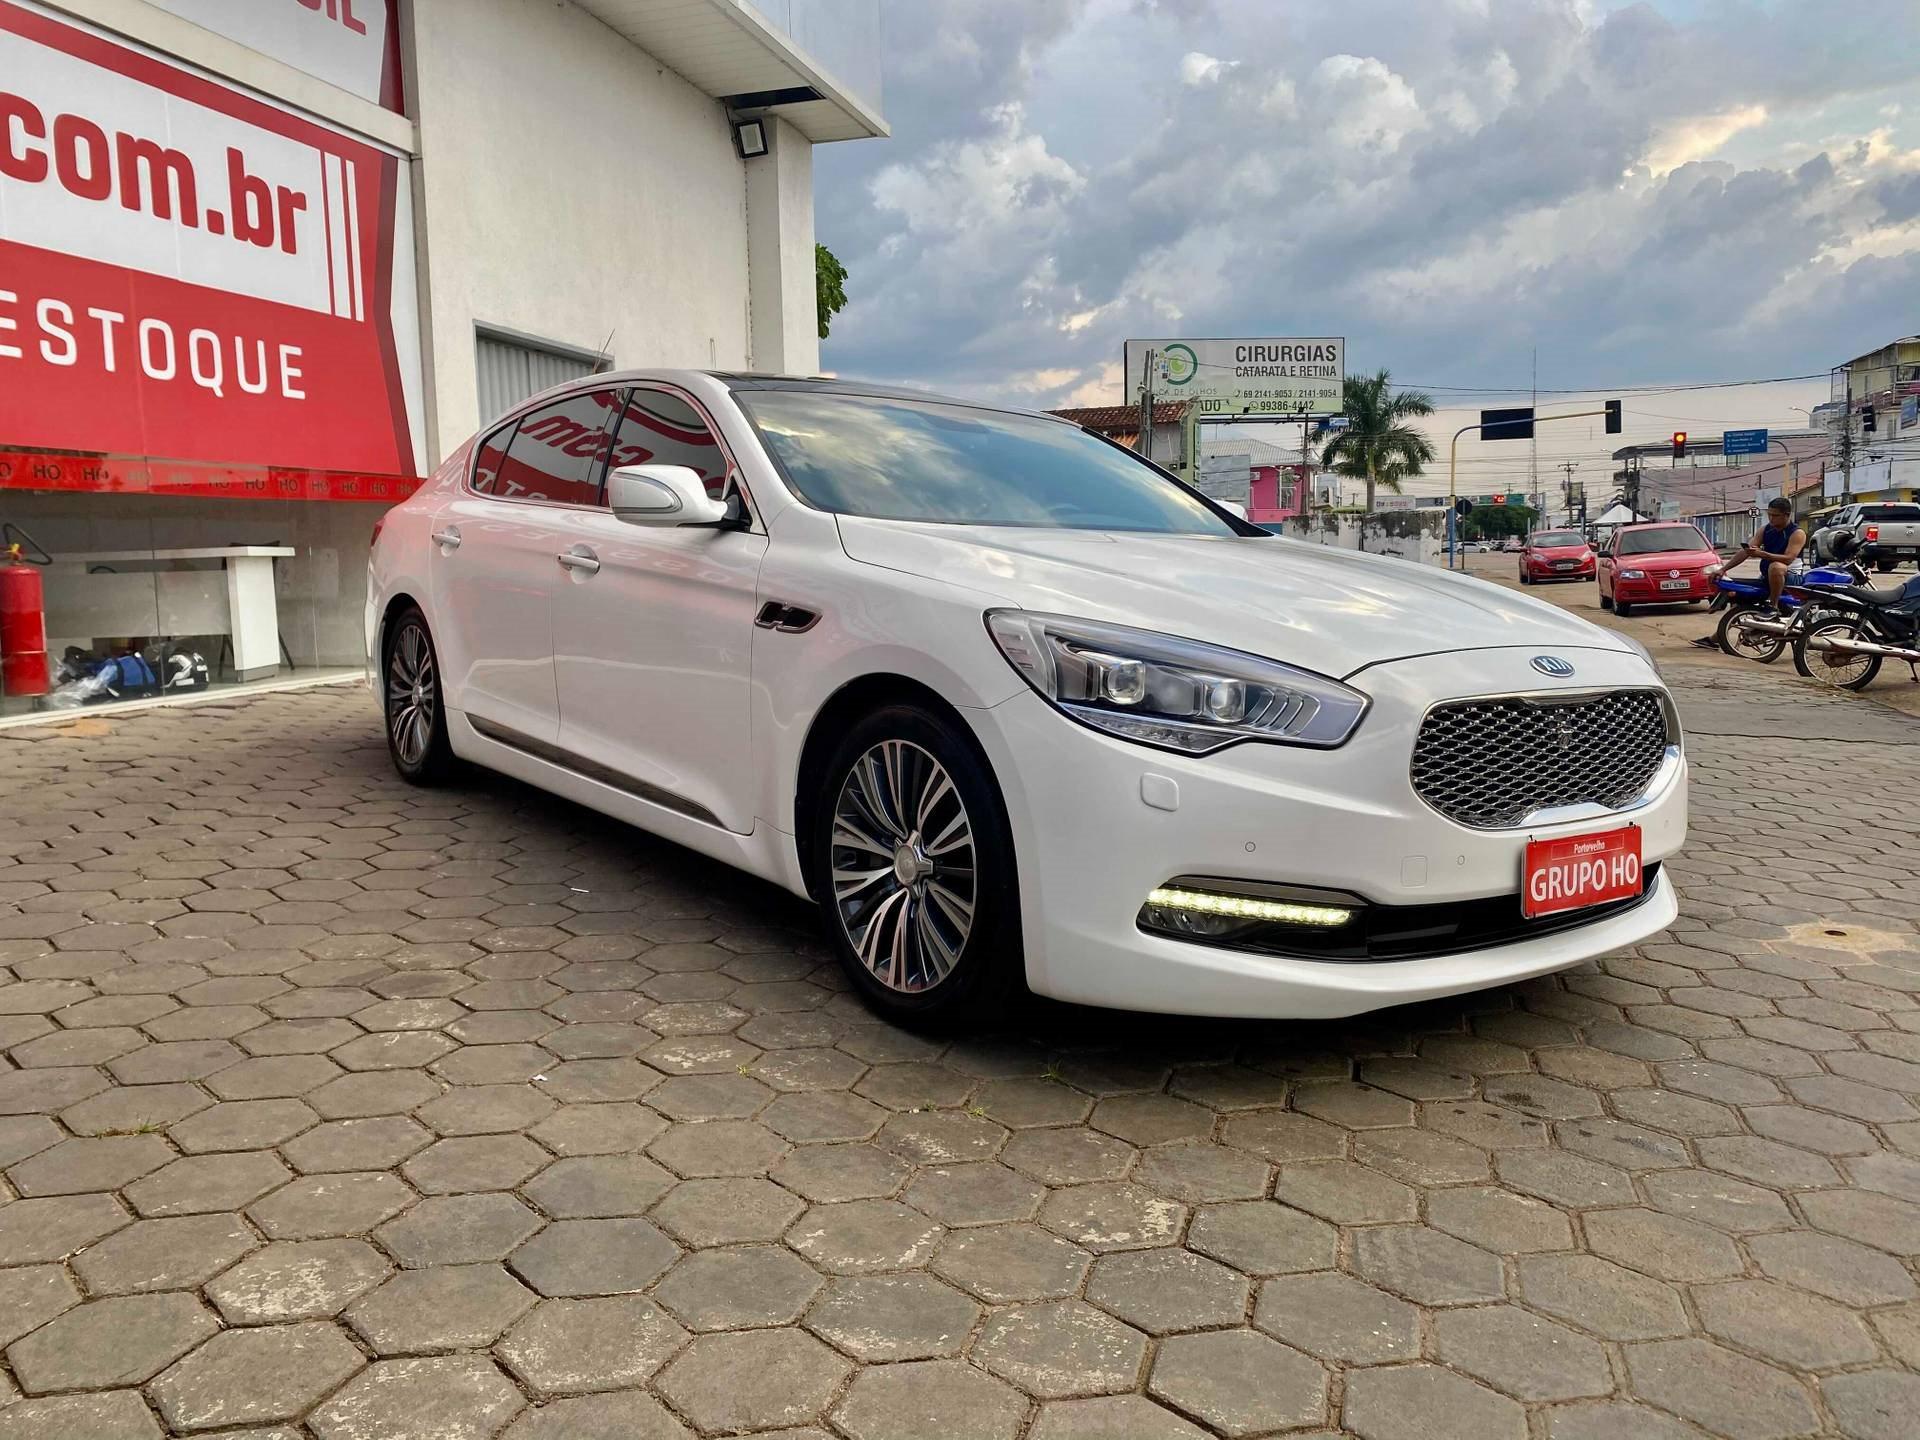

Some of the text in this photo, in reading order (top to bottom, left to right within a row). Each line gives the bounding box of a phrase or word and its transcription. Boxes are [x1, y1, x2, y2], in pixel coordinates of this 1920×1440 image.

[0, 92, 307, 256] com.br
[1235, 345, 1337, 362] CIRURGIAS
[1235, 365, 1337, 377] CATARATA E RETINA
[1243, 390, 1253, 398] 69
[1254, 389, 1293, 398] 2141-9053
[1299, 389, 1337, 398] 2141-9054
[32, 464, 62, 480] HO
[279, 478, 299, 493] HO
[311, 479, 330, 493] HO
[341, 481, 359, 494] HO
[1542, 656, 1574, 672] KIA
[1530, 852, 1639, 902] GRUPO HO
